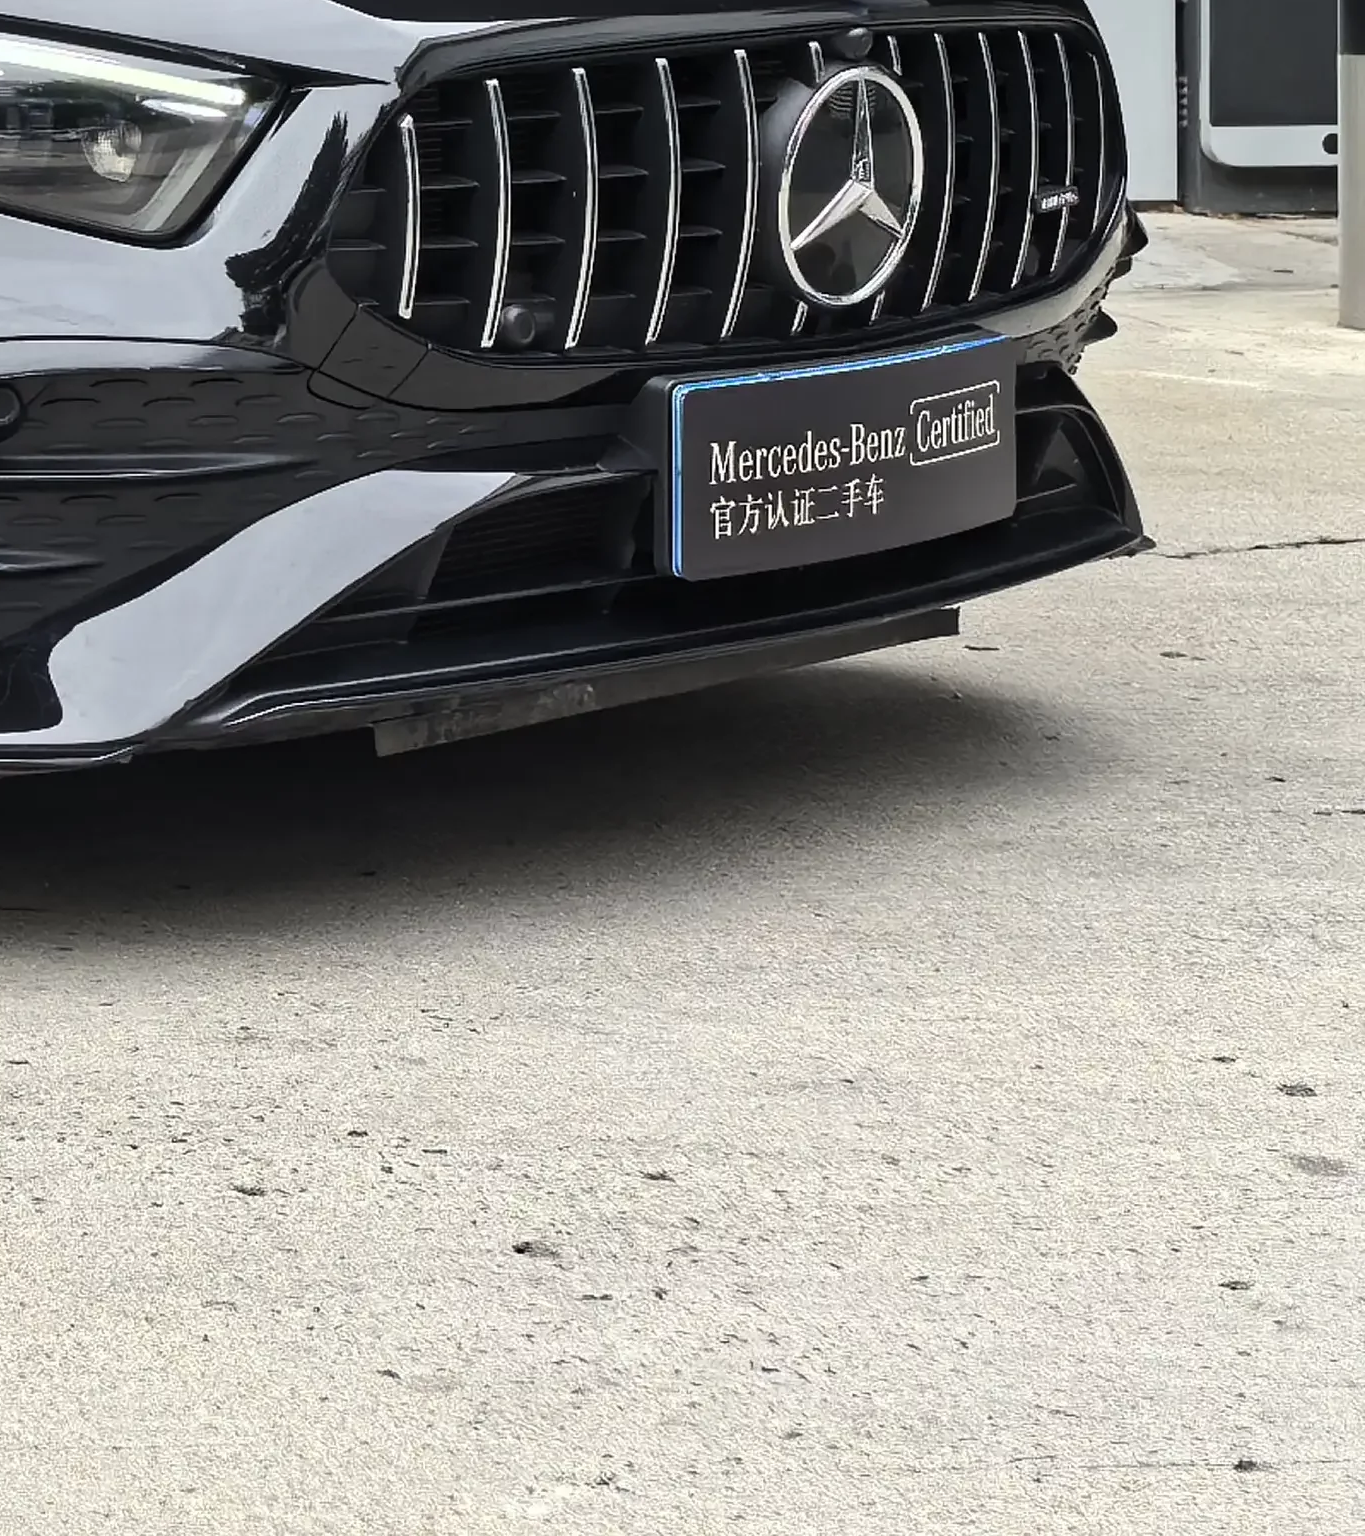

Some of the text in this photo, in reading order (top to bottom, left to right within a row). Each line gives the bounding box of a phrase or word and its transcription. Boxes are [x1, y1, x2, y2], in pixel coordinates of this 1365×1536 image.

[709, 393, 995, 485] Mercedes-Benz Certified
[709, 473, 885, 541] 官方认证二手车
